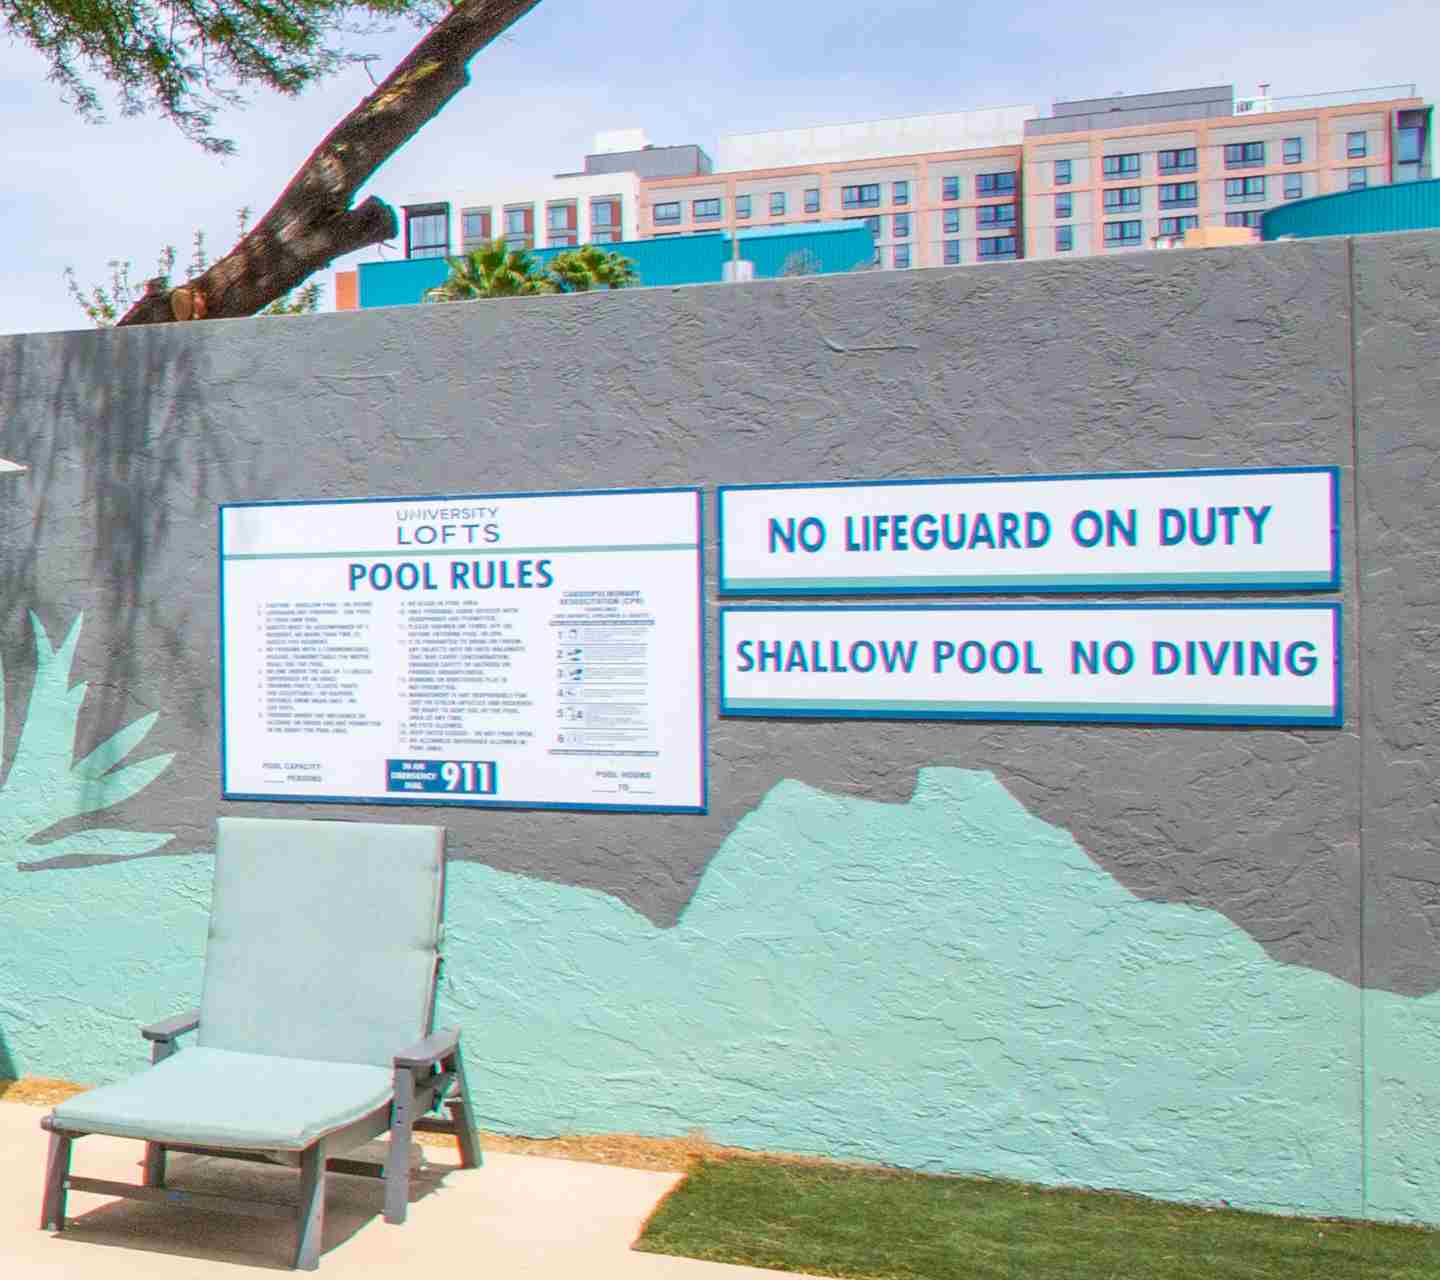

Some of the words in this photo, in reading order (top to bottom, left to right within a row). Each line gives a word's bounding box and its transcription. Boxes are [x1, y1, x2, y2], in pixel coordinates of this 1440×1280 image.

[396, 507, 499, 521] UNIVERSITY
[768, 517, 826, 553] NO
[844, 512, 1052, 552] LIFEGUARD
[1071, 508, 1137, 548] ON
[1158, 505, 1272, 547] DUTY
[397, 523, 500, 545] LOFTS
[348, 561, 438, 592] POOL
[449, 558, 554, 590] RULES
[735, 640, 918, 673] SHALLOW
[932, 641, 1043, 674] POOL
[1070, 640, 1136, 676] NO
[1152, 640, 1319, 677] DIVING
[441, 762, 490, 792] 911
